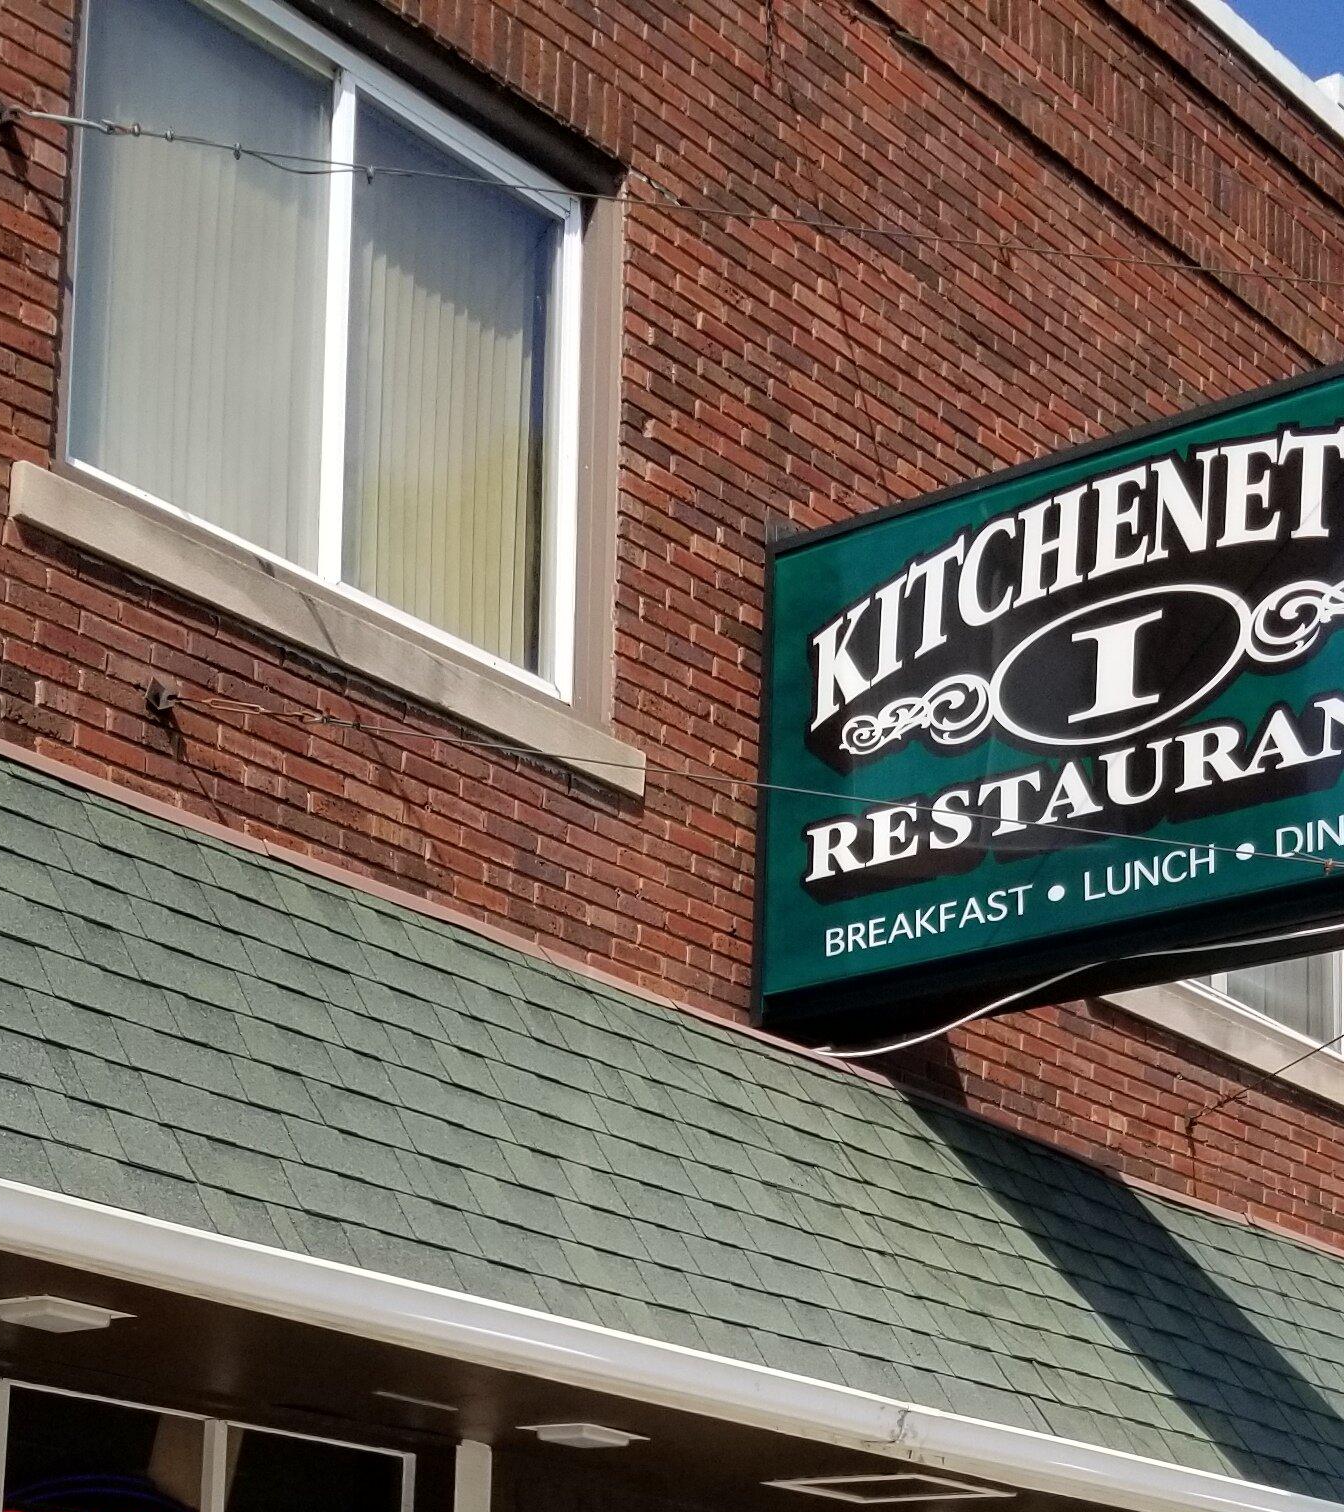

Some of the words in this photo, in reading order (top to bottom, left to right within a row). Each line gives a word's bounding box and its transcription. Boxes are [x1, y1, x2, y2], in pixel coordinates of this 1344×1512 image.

[1067, 609, 1164, 725] I
[824, 883, 1034, 958] BREAKFAST
[1083, 844, 1216, 902] LUNCH
